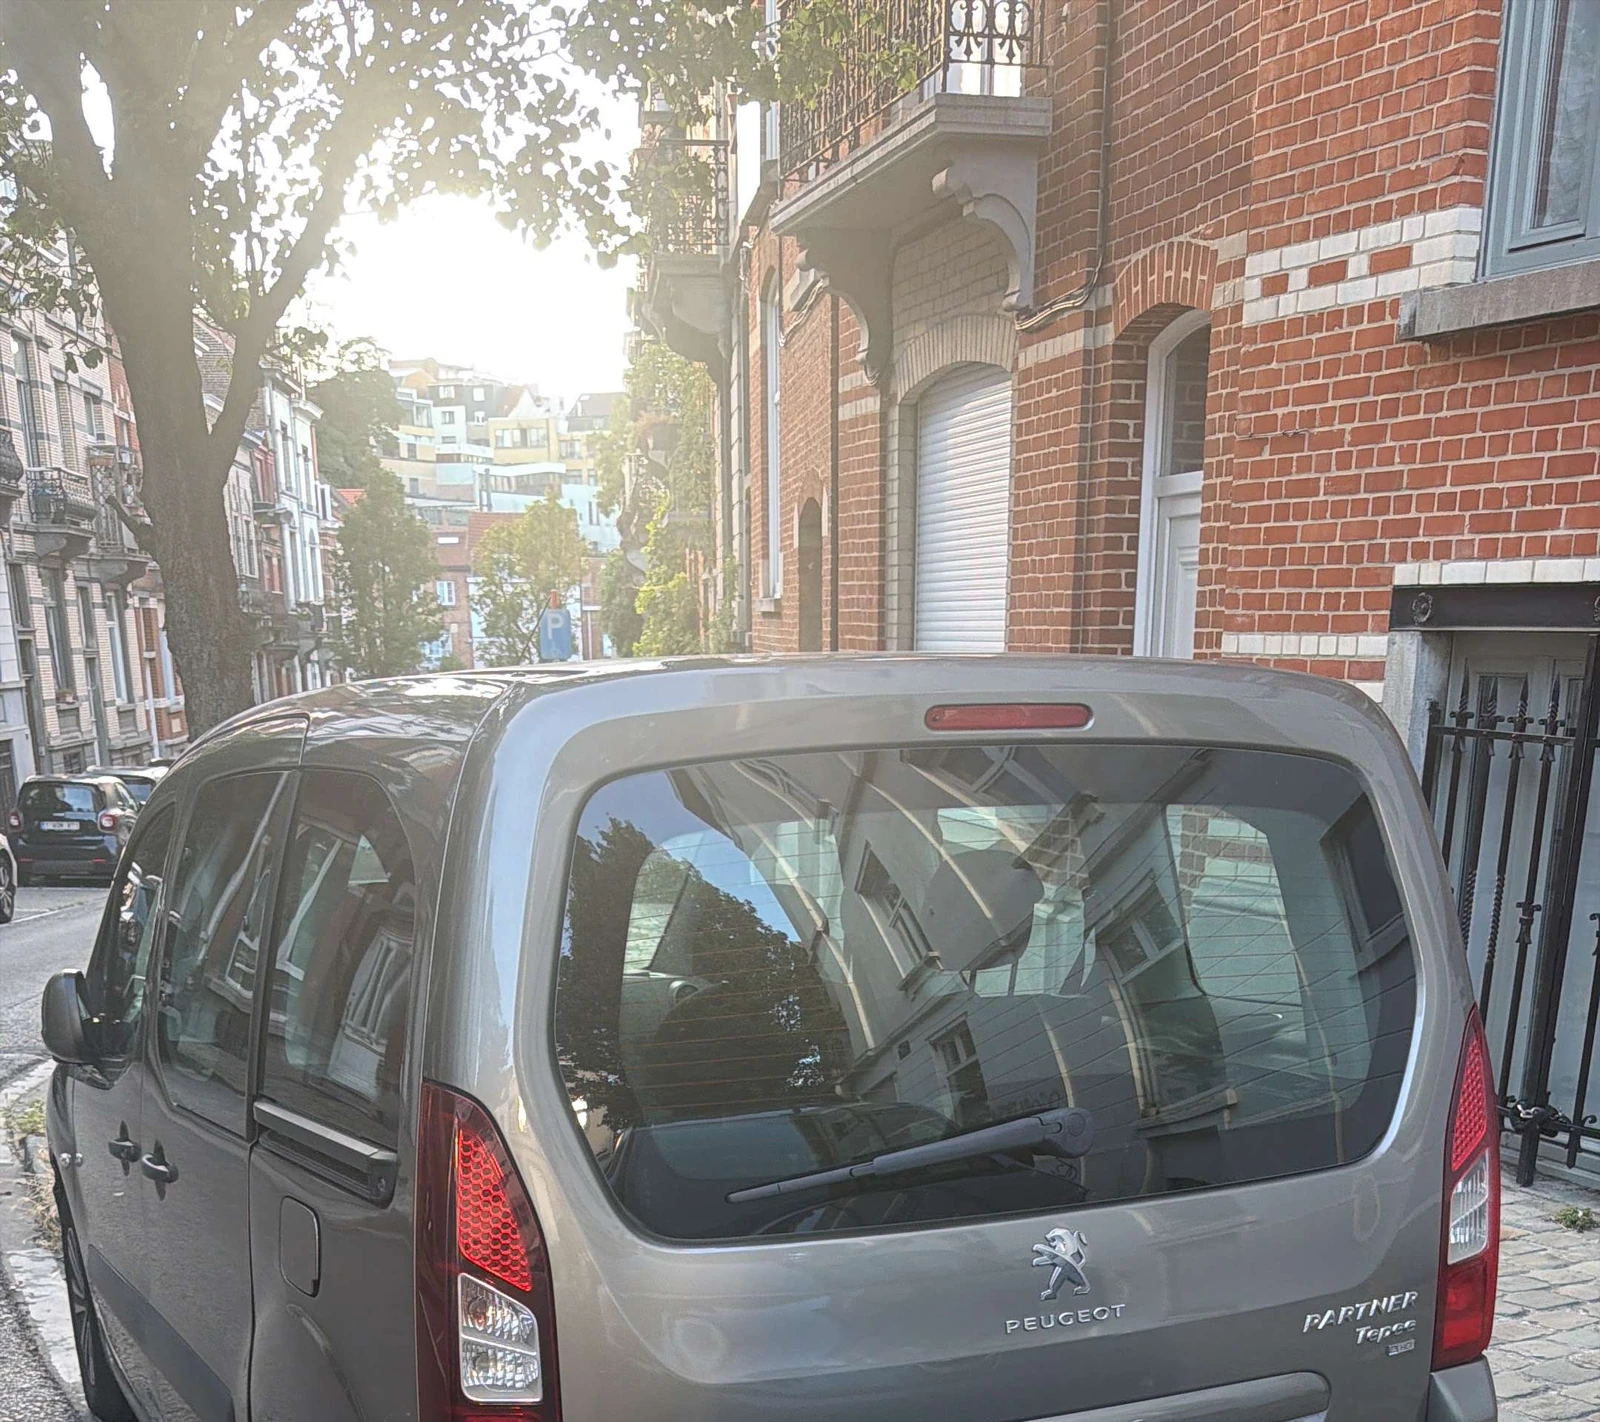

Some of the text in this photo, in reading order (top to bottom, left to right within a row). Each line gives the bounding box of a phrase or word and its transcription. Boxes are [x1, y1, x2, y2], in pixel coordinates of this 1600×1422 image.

[547, 611, 565, 639] P
[1005, 1303, 1126, 1334] PEUGEOT
[1302, 1291, 1419, 1333] PARTNER
[1356, 1319, 1417, 1344] Tepee
